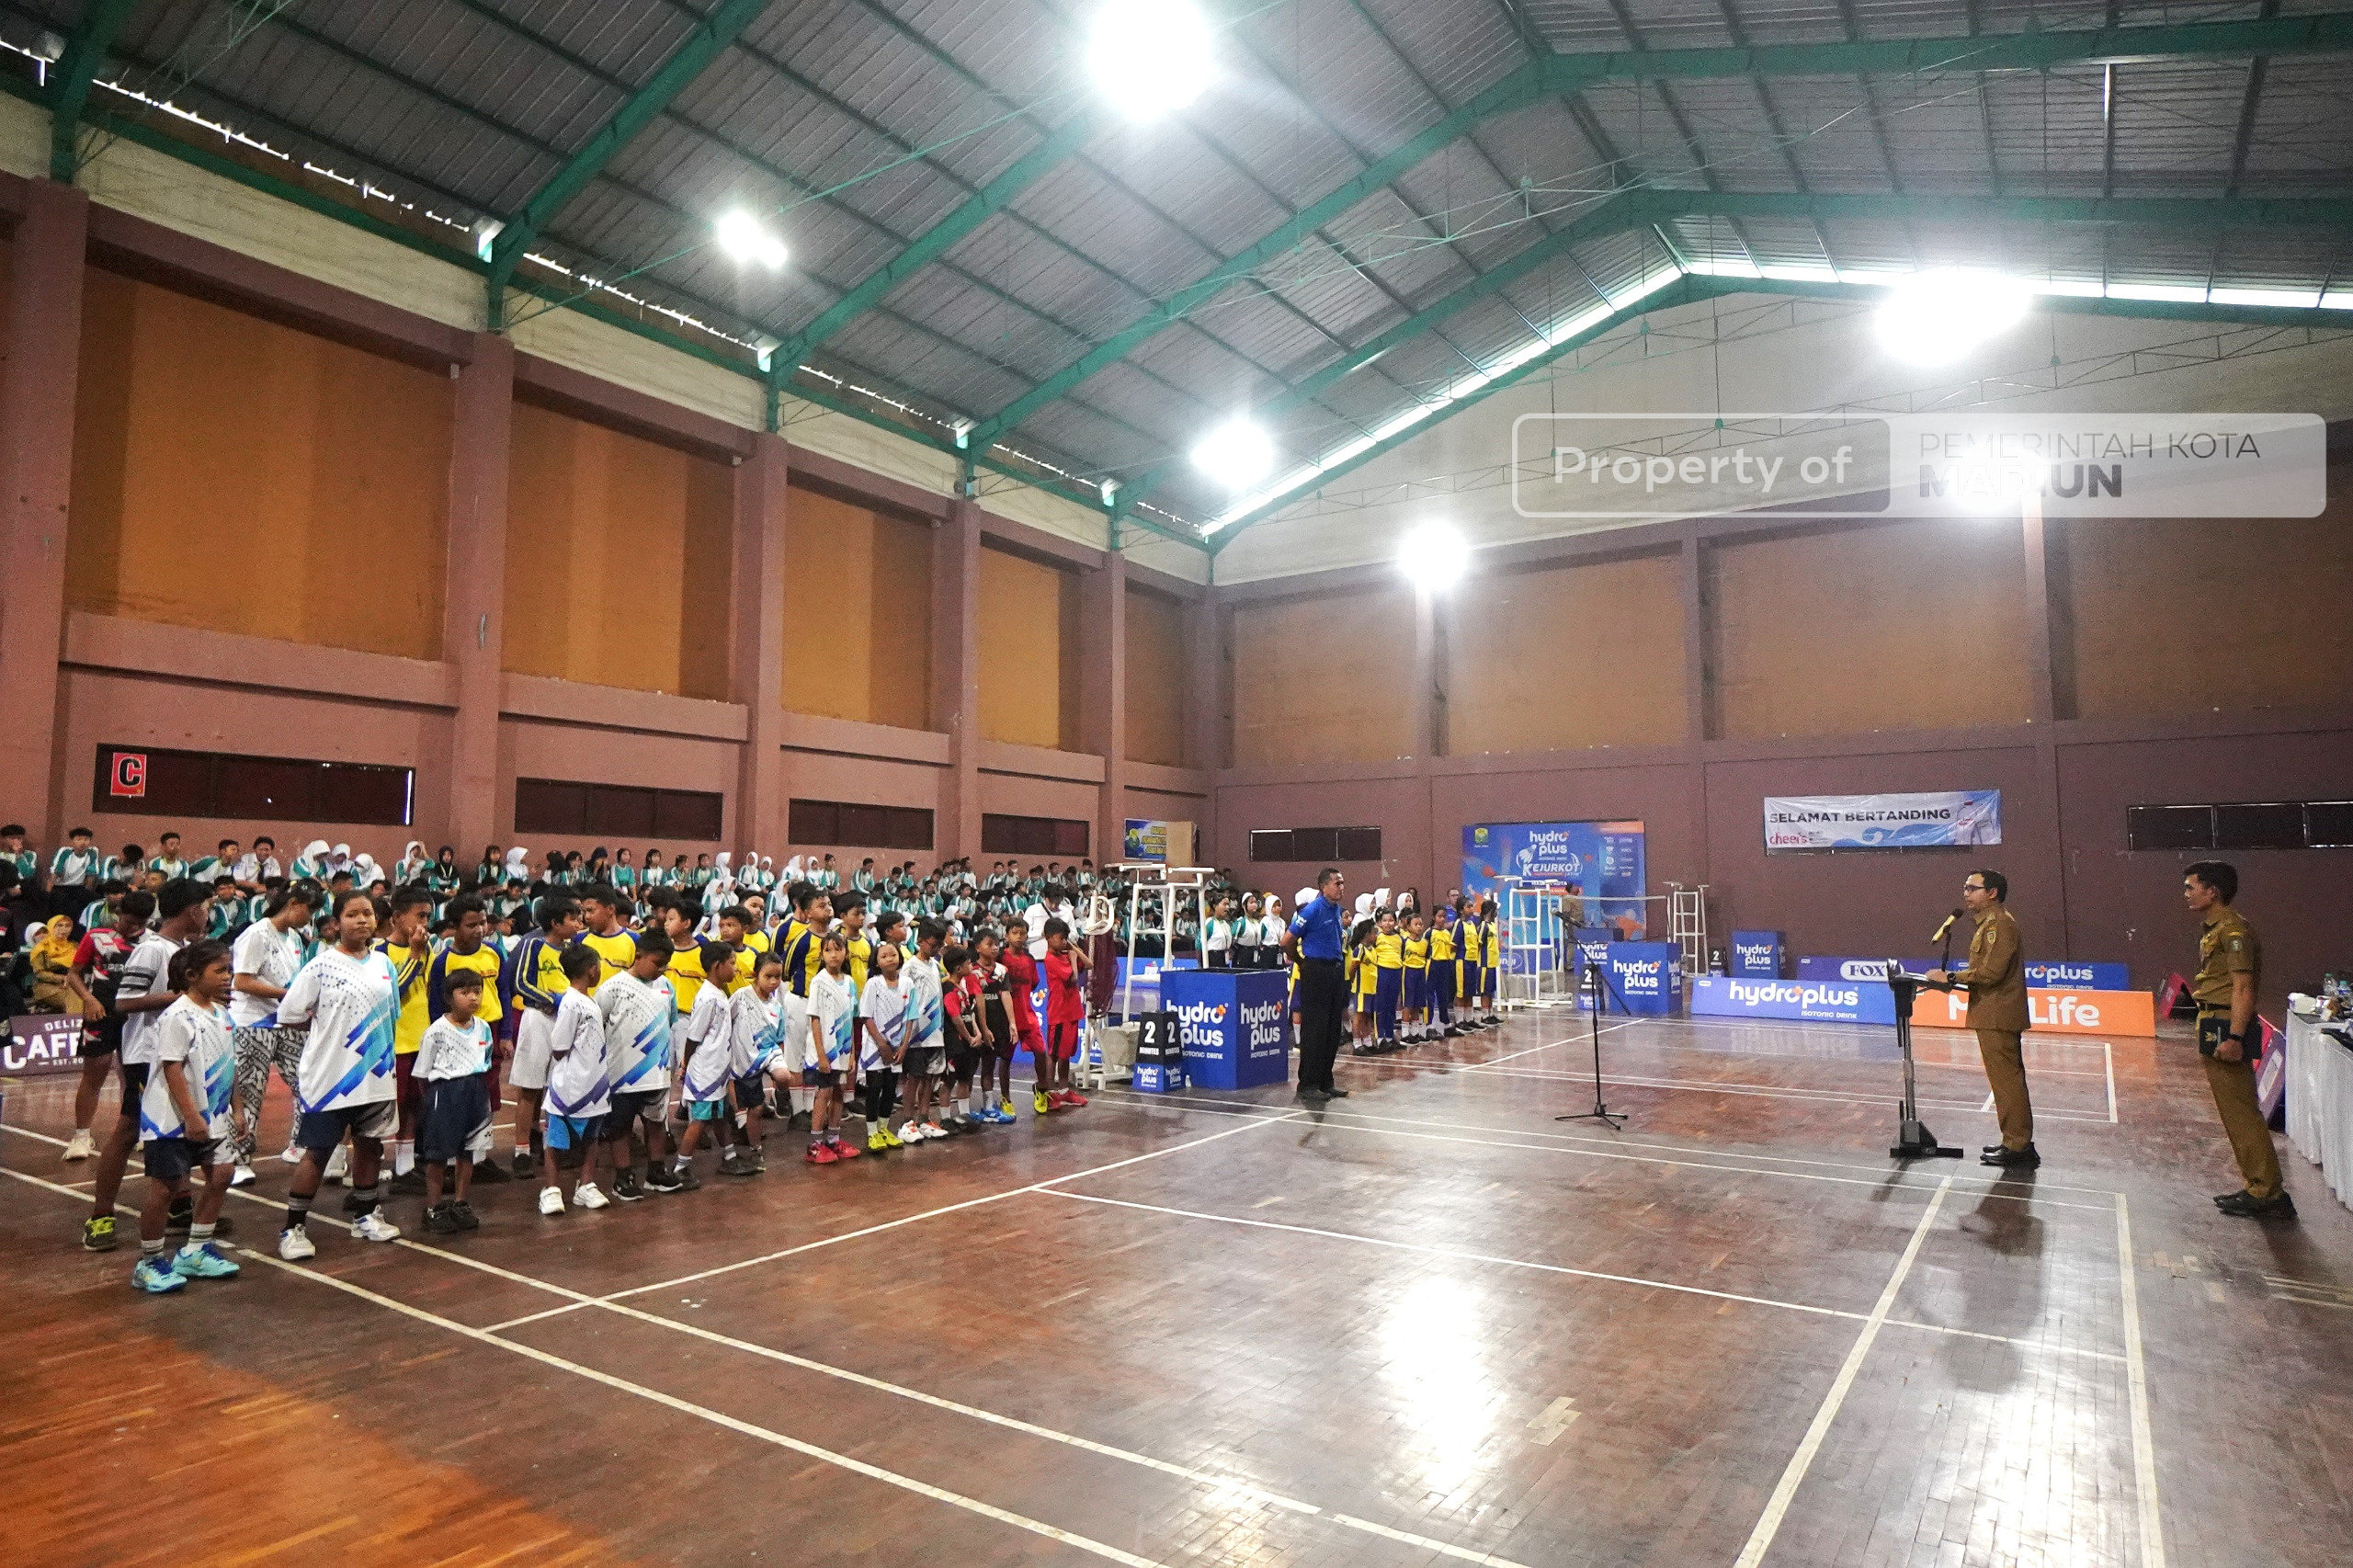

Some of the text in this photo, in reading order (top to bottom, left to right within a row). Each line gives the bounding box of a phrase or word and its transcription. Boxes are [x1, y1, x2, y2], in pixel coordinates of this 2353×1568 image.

[119, 756, 142, 788] C
[1769, 809, 1950, 824] SELAMAT BERTANDING
[1529, 831, 1568, 846] hydro
[1769, 832, 1807, 845] cheers
[1538, 844, 1567, 856] plus
[1522, 862, 1579, 876] KEJURKOT
[1712, 950, 1720, 960] 2
[1736, 943, 1772, 957] hydro
[1613, 959, 1660, 976] hydro
[1745, 954, 1770, 966] plus
[1624, 973, 1658, 990] plus
[1729, 981, 1859, 1009] hydroplus
[1240, 1000, 1282, 1029] hydro
[1802, 1009, 1858, 1019] ISOTONIC DRINK
[44, 1018, 84, 1031] DELIZ
[1144, 1020, 1156, 1044] 2
[1166, 1021, 1176, 1043] 2
[1179, 1023, 1224, 1048] plus
[1251, 1023, 1280, 1051] plus
[4, 1031, 81, 1070] CAFF
